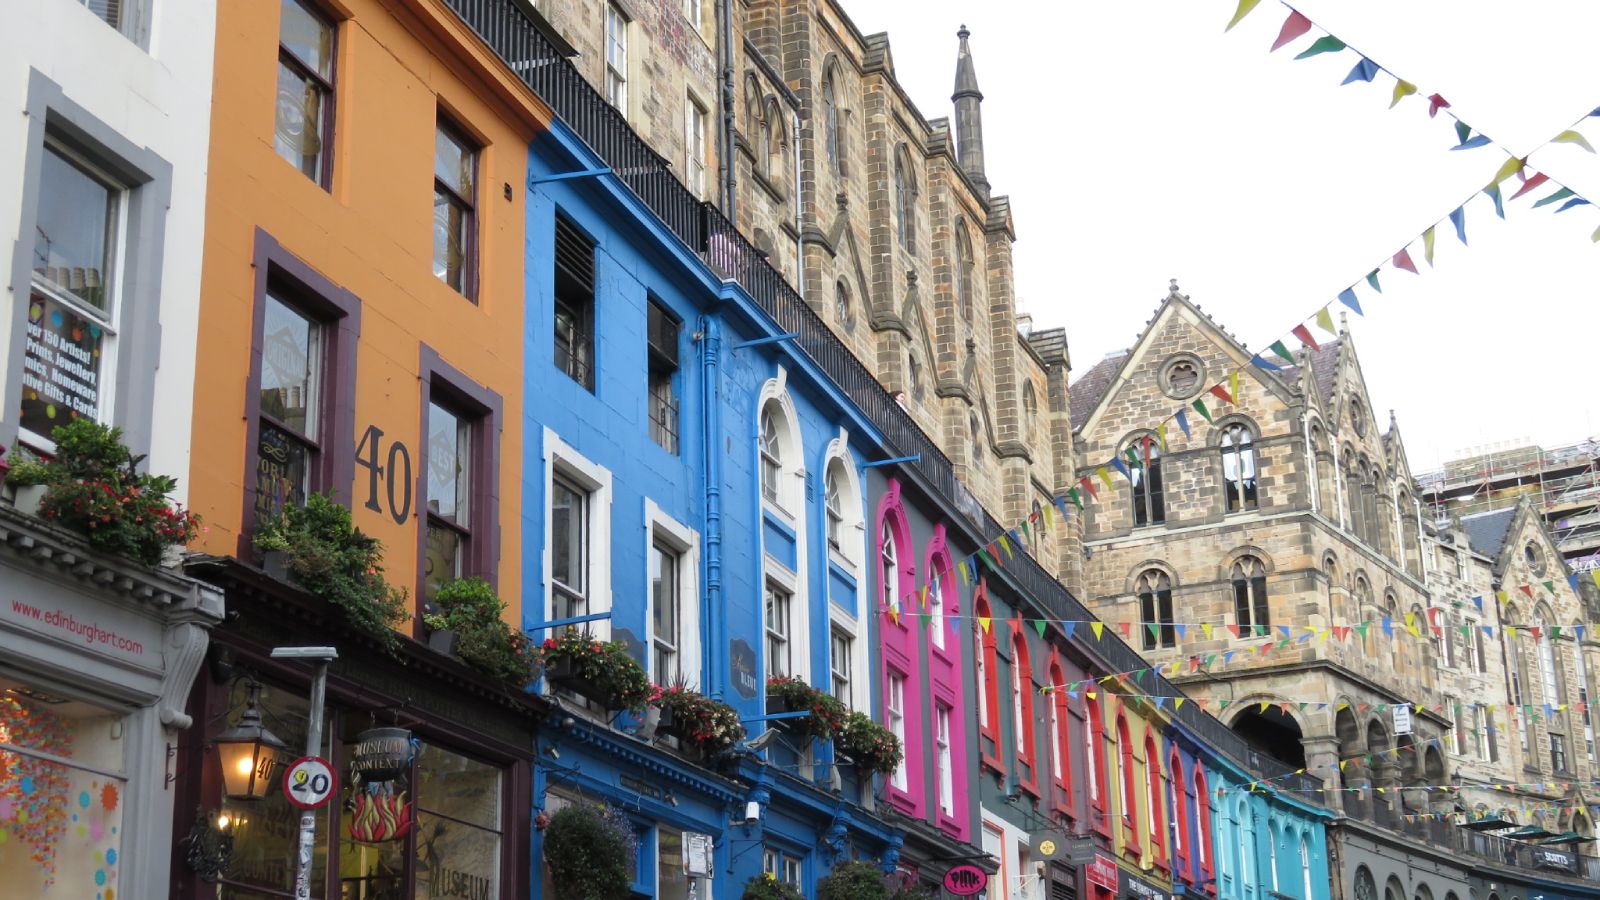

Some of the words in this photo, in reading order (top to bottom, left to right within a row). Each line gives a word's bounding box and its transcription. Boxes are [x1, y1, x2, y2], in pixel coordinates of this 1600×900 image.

[27, 337, 55, 363] Prints,
[56, 352, 97, 386] Jewellery,
[43, 329, 59, 347] 150
[59, 337, 91, 364] Artists!
[44, 382, 64, 404] Gifts
[65, 394, 72, 408] &
[72, 396, 98, 419] Cards
[52, 367, 97, 402] Homeware
[354, 424, 412, 526] 40
[11, 599, 144, 655] www.edinburghart.com
[354, 739, 402, 757] MUSEUM
[355, 758, 400, 771] CONTEXT
[257, 757, 273, 780] 40
[292, 770, 329, 795] 20
[1544, 851, 1569, 865] SCOTTS
[429, 864, 490, 900] MUSEUM
